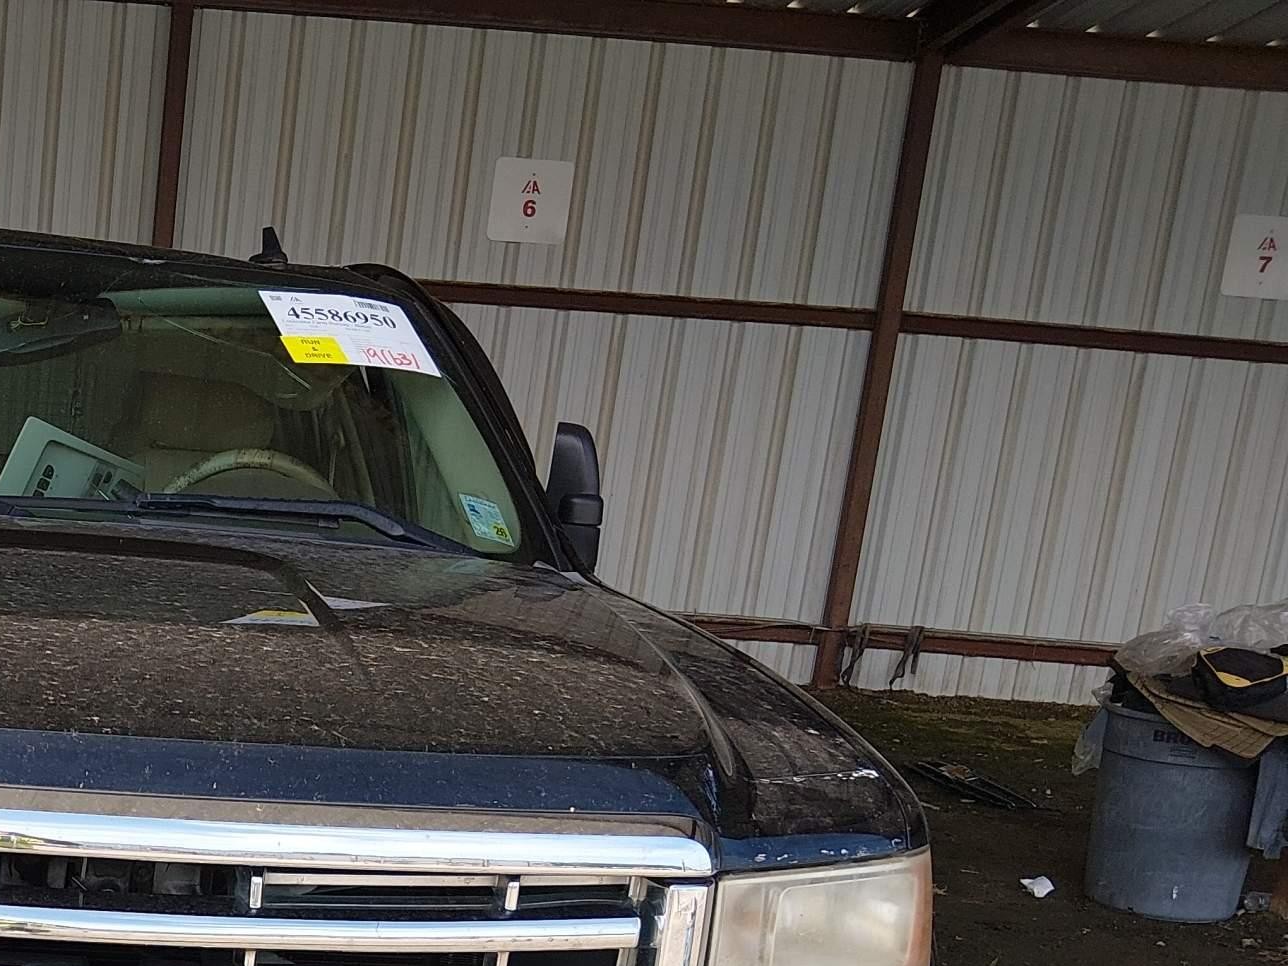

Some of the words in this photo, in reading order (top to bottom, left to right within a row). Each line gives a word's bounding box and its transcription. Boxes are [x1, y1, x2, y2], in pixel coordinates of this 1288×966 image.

[522, 199, 537, 218] 6
[1259, 256, 1273, 273] 7
[288, 306, 397, 329] 45586950
